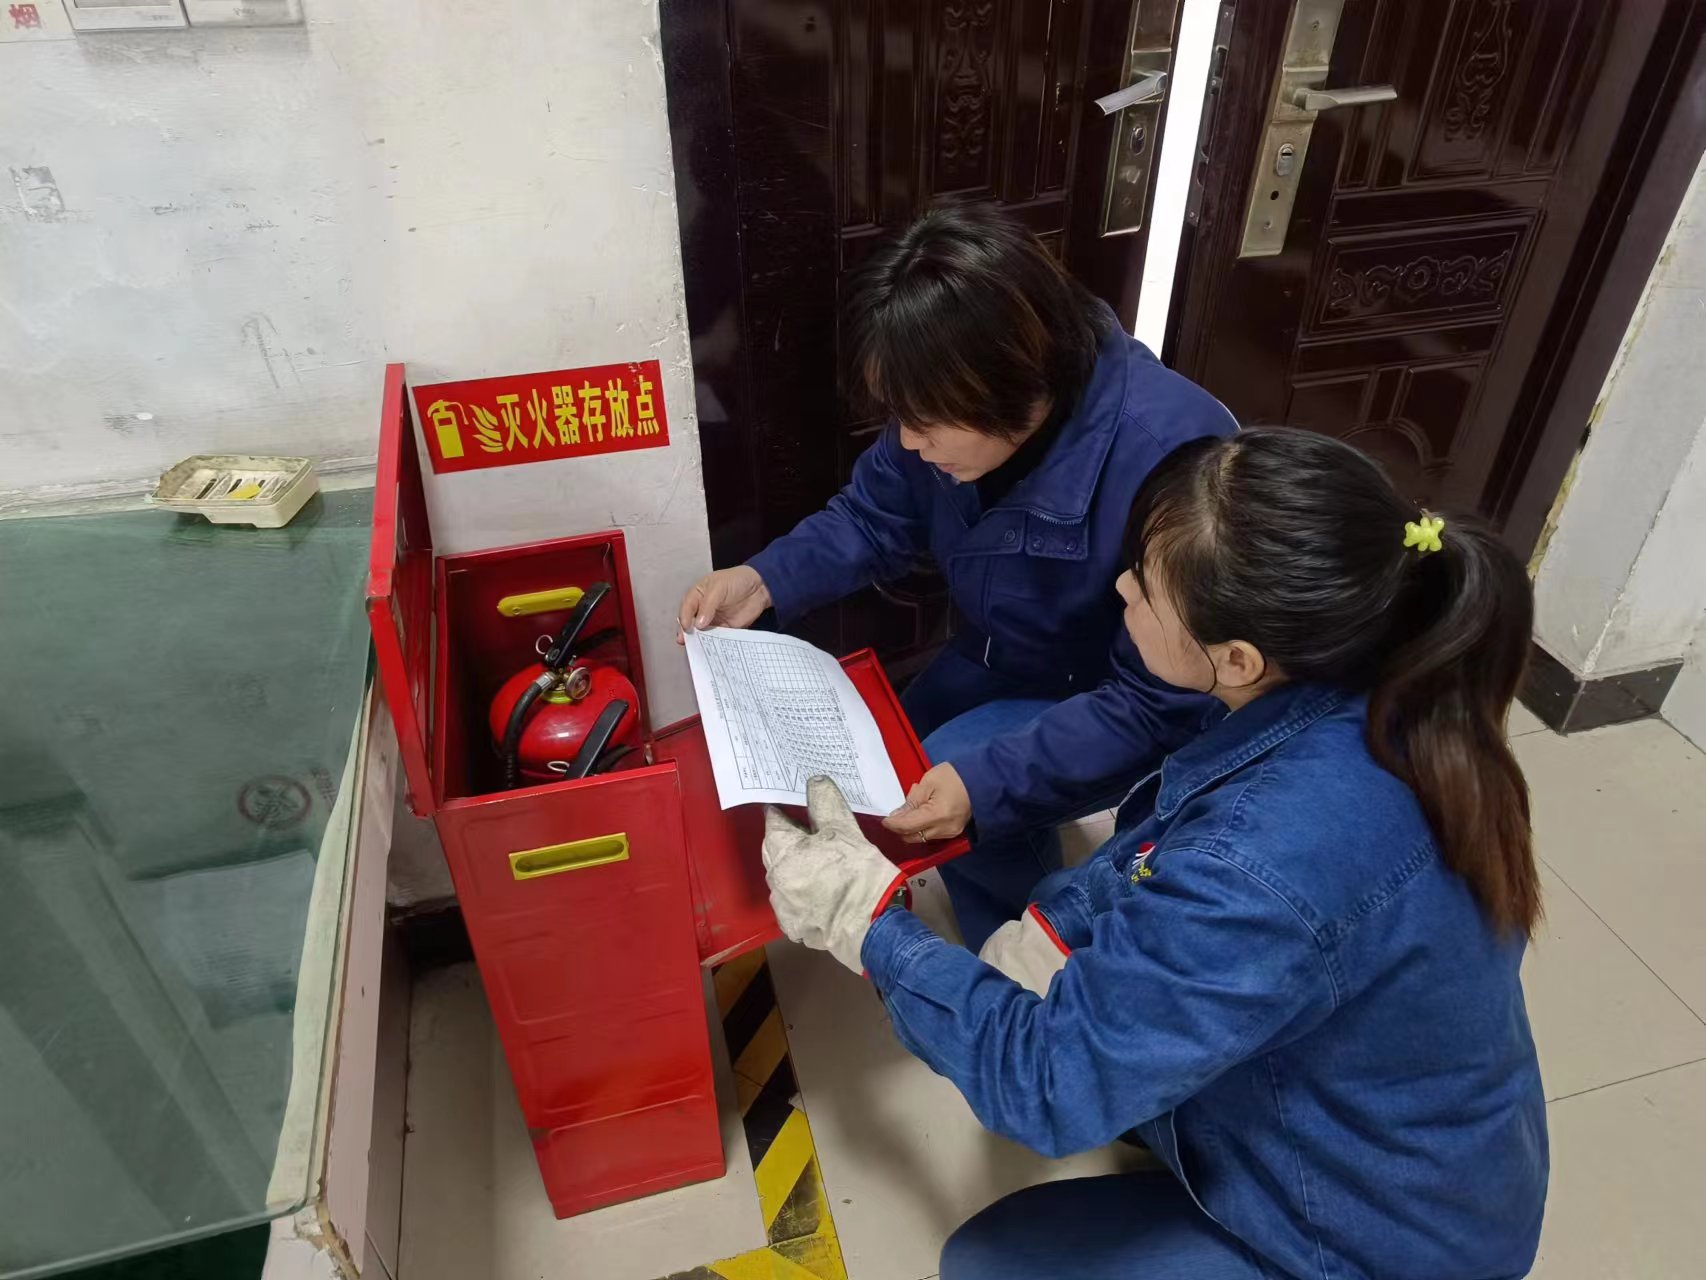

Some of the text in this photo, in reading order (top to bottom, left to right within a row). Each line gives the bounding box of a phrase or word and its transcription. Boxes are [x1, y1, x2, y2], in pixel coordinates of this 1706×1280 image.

[496, 375, 660, 452] 灭火器存放点
